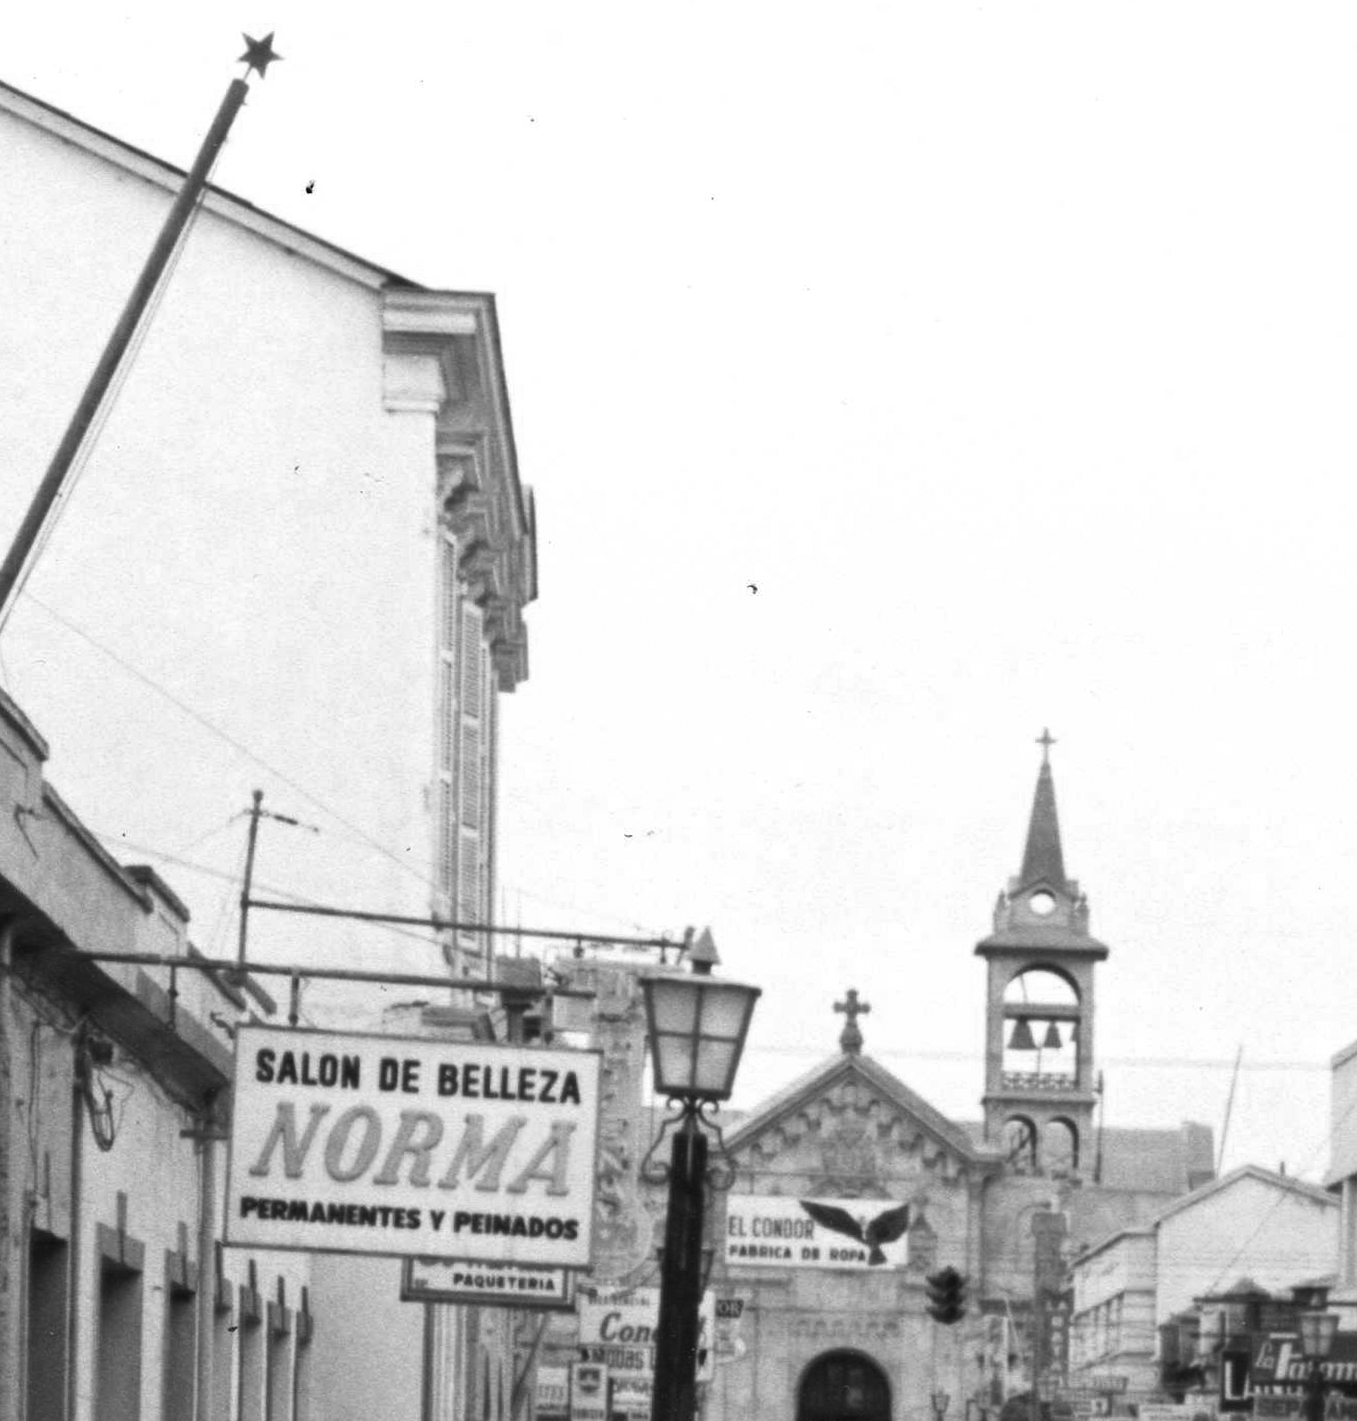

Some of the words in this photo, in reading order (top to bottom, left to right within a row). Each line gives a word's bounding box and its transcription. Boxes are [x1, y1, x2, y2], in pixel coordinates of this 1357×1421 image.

[256, 1048, 361, 1090] SALON
[379, 1056, 421, 1094] DE
[438, 1062, 582, 1105] BELLEZA
[248, 1101, 578, 1197] NORMA
[240, 1196, 421, 1230] PERMANENTES
[430, 1210, 446, 1232] Y
[453, 1210, 579, 1240] PEINADOS
[728, 1215, 748, 1237] EL
[752, 1217, 815, 1240] CONDOR
[728, 1244, 793, 1260] FABRICA
[829, 1248, 867, 1262] ROPA
[453, 1272, 556, 1291] PAQUETERIA
